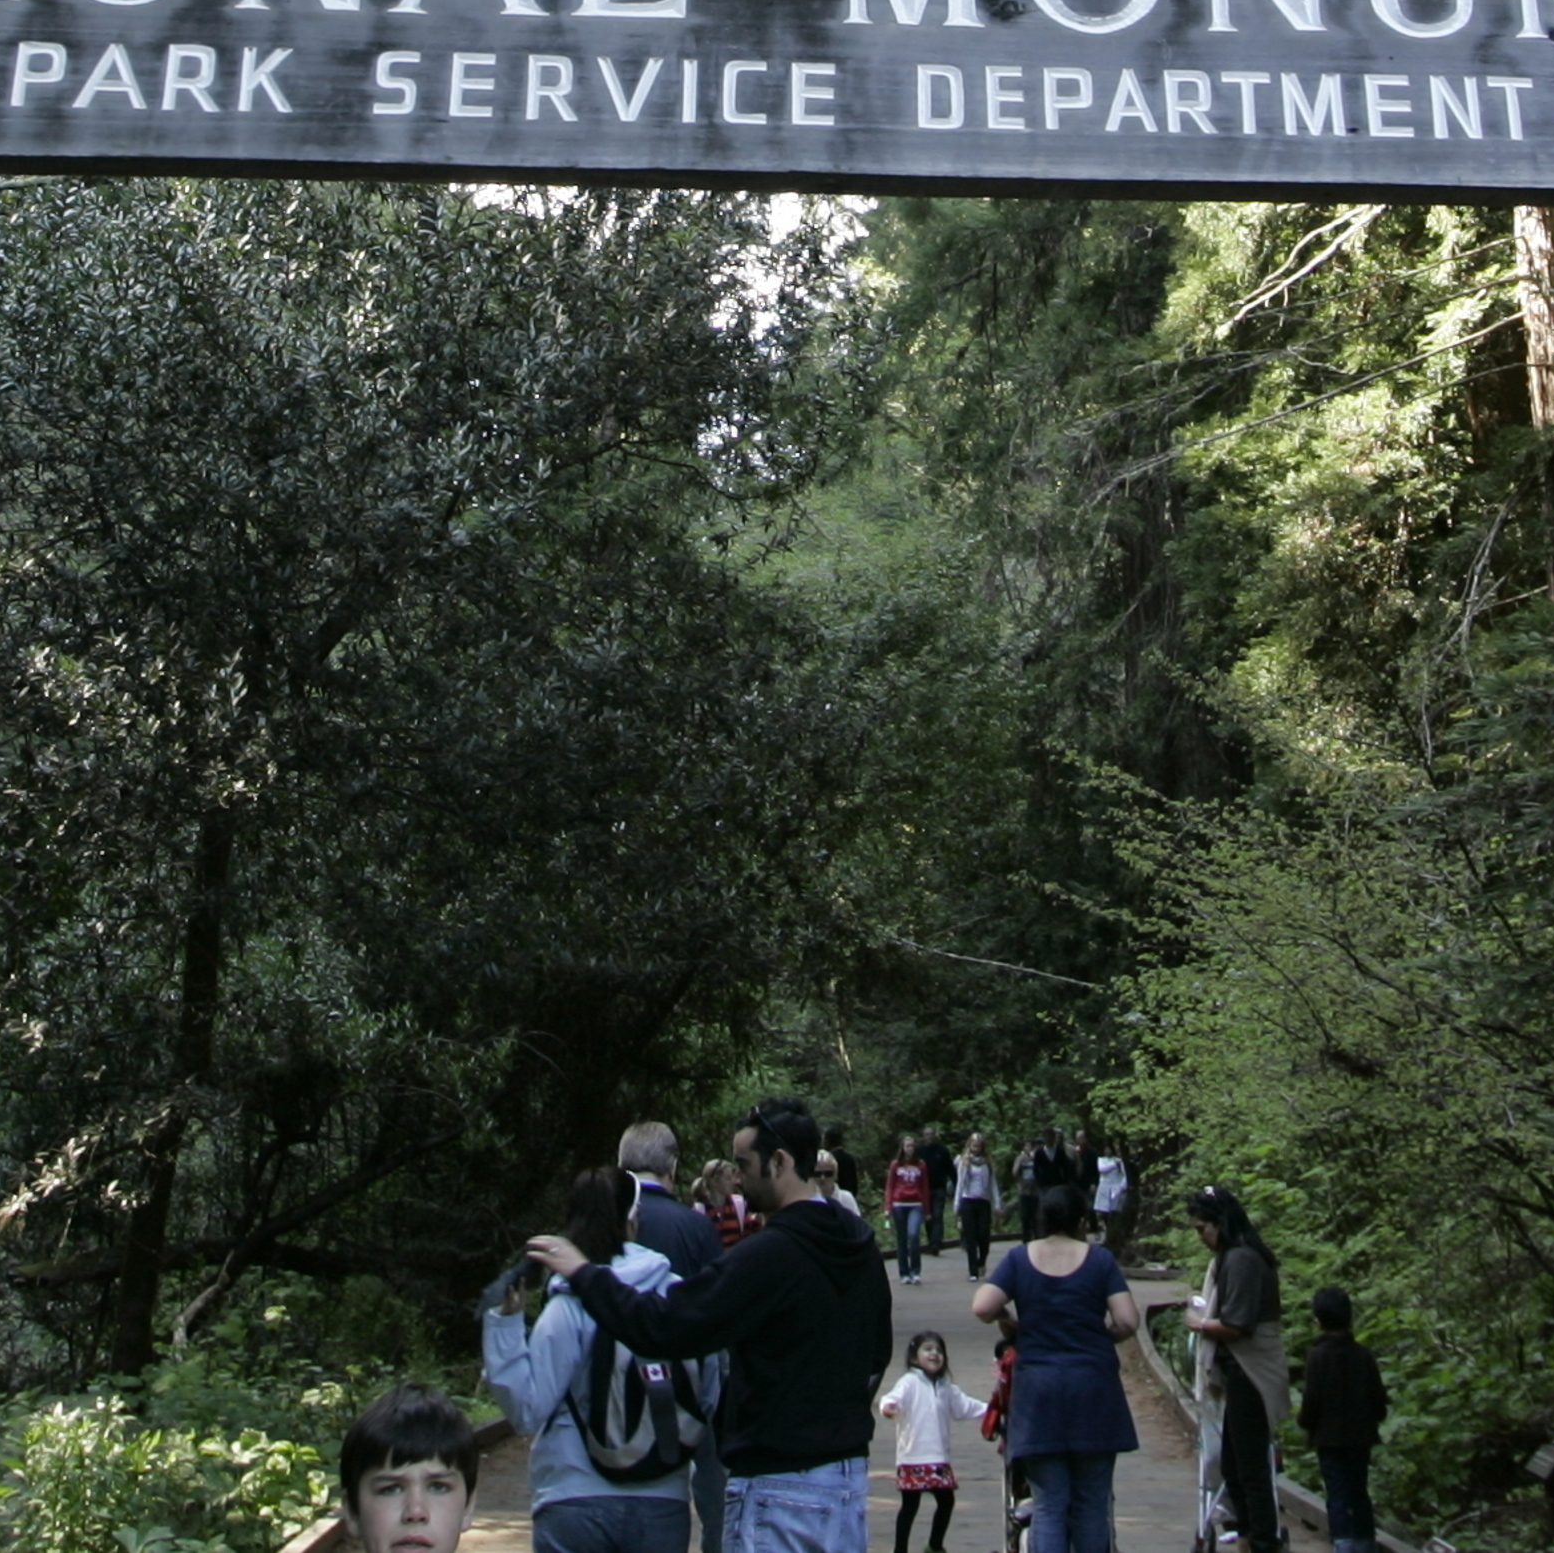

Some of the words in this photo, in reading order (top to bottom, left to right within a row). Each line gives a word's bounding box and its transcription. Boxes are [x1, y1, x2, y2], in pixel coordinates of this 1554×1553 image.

[10, 40, 294, 114] PARK
[370, 49, 838, 127] SERVICE
[915, 64, 1535, 142] DEPARTMENT
